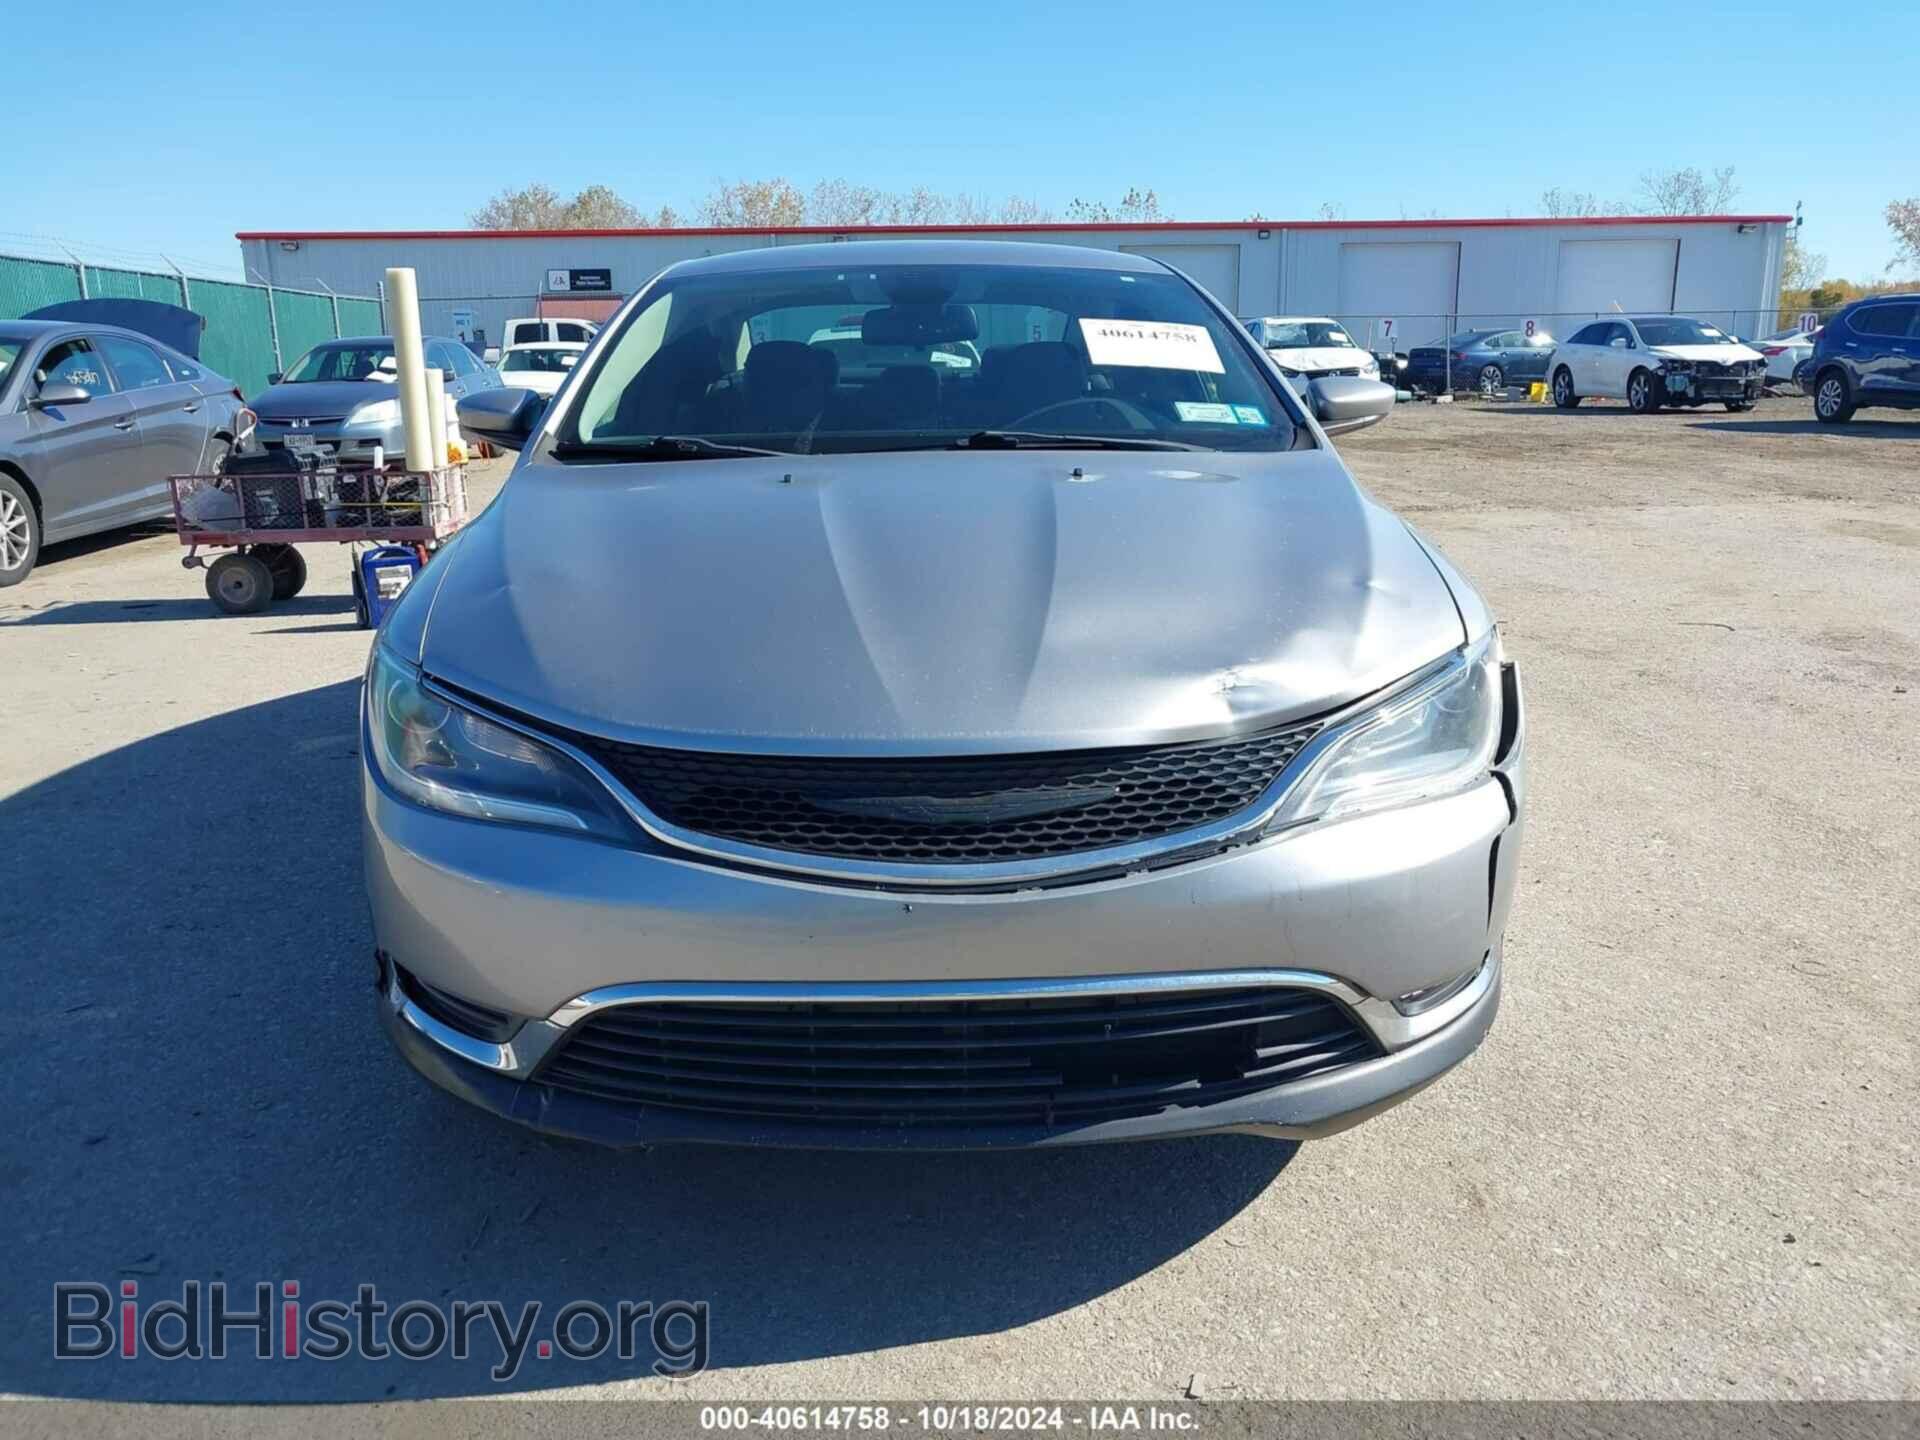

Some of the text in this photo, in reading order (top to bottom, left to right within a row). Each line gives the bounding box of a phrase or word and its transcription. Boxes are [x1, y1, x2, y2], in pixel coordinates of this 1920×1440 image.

[1384, 320, 1392, 337] 7
[1525, 320, 1534, 337] 8
[1800, 315, 1816, 332] 10
